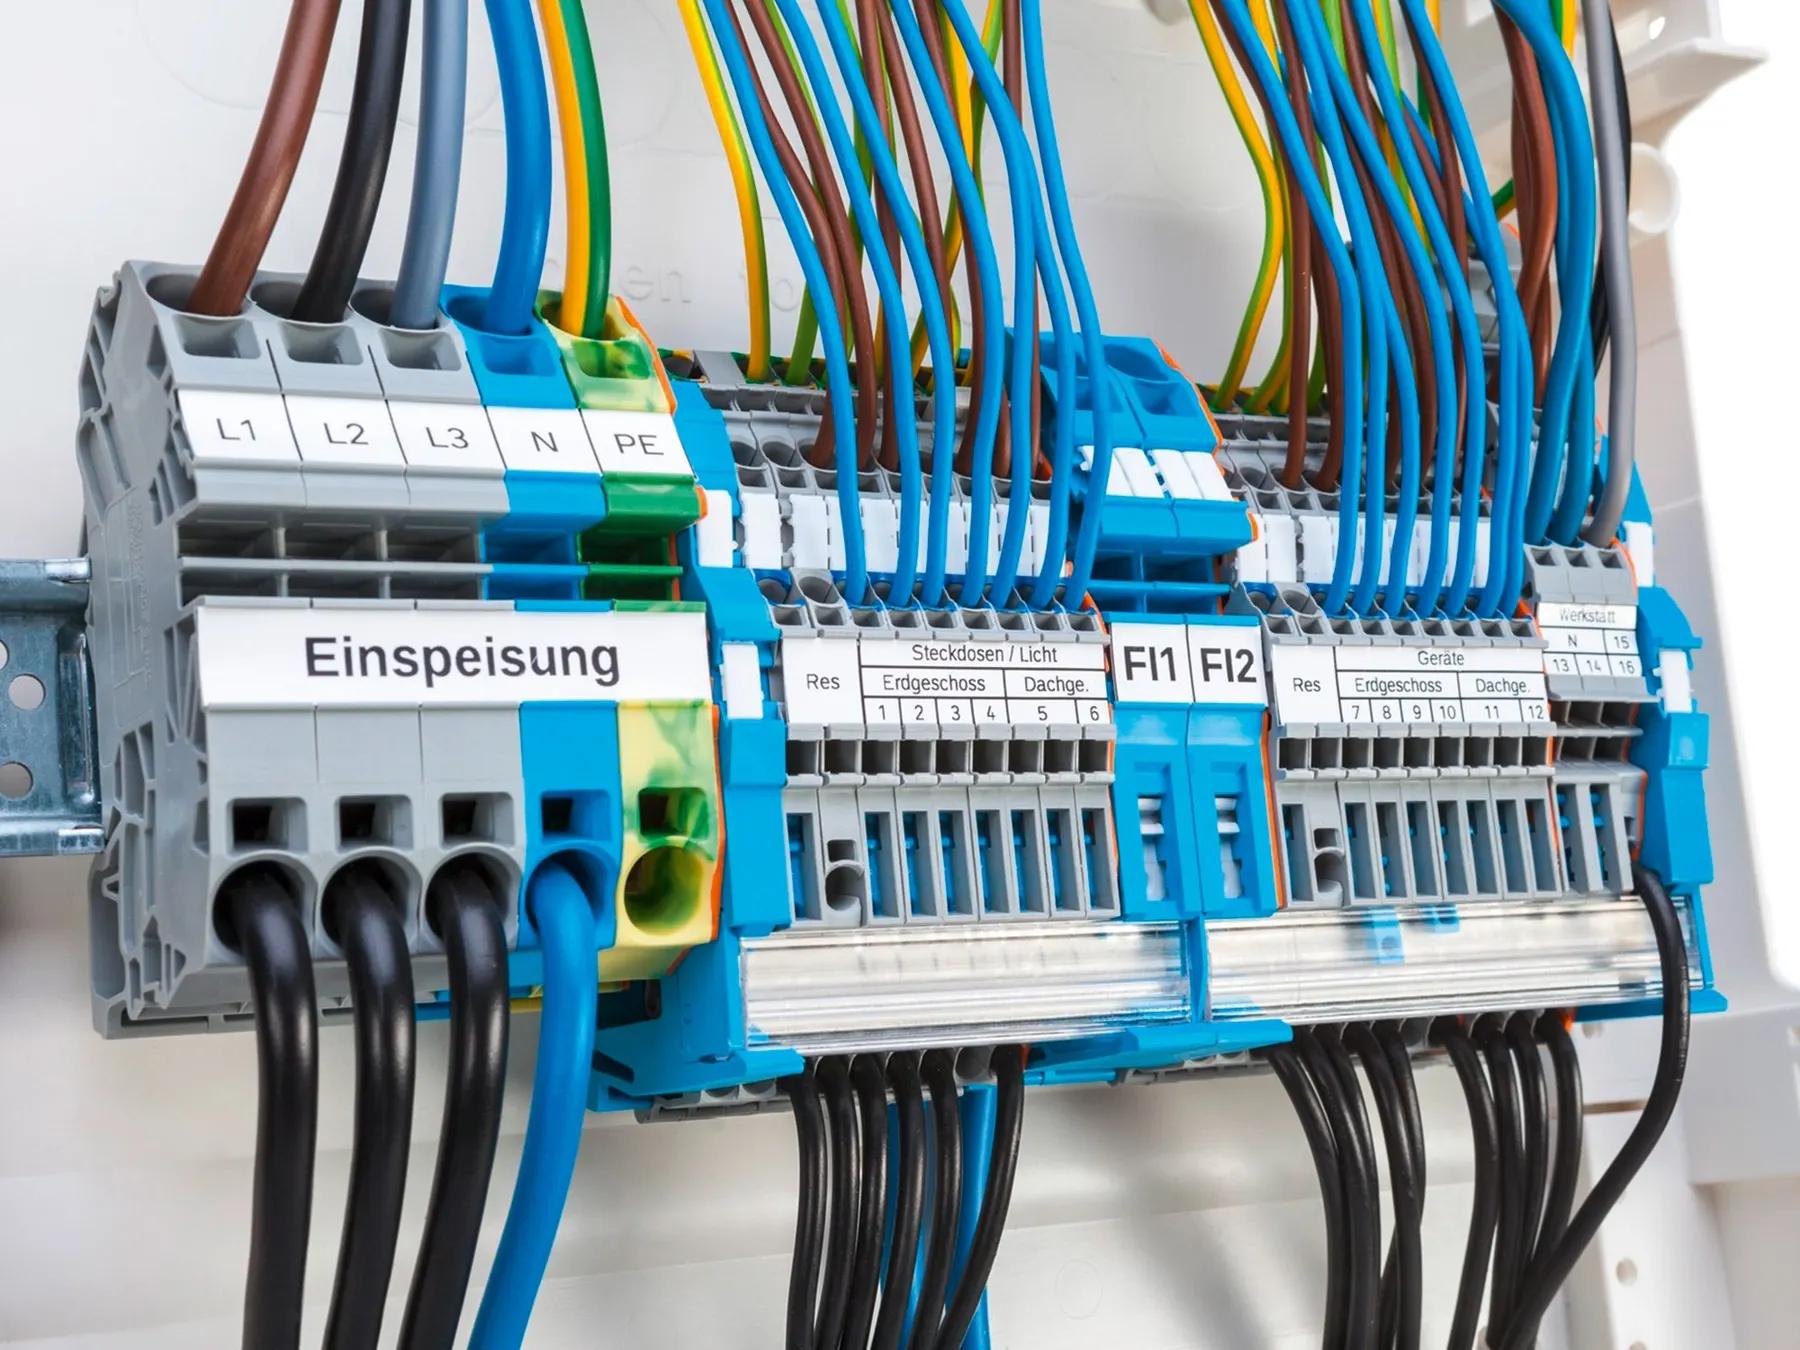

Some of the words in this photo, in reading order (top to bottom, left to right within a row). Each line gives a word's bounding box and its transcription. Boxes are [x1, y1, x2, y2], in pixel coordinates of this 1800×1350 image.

[216, 418, 257, 442] L1
[323, 422, 370, 446] L2
[425, 426, 470, 450] L3
[530, 431, 559, 453] N
[613, 433, 665, 456] PE
[1558, 608, 1618, 625] Werkstatt
[1567, 634, 1579, 648] N
[1612, 634, 1631, 650] 15
[305, 634, 621, 688] Einspeisung
[911, 643, 1005, 663] Steckdosen
[1018, 645, 1059, 664] Licht
[1416, 649, 1466, 668] Geräte
[1123, 645, 1178, 683] FI1
[1200, 647, 1259, 684] FI2
[1551, 657, 1571, 673] 13
[1585, 658, 1603, 674] 14
[1617, 659, 1637, 675] 16
[806, 672, 842, 691] Res
[882, 673, 987, 695] Erdgeschoss
[1023, 674, 1090, 697] Dachge.
[1292, 676, 1323, 694] Res
[1354, 676, 1444, 697] Erdgeschoss
[1474, 676, 1532, 697] Dachge.
[878, 704, 887, 722] 1
[913, 704, 926, 722] 2
[950, 704, 962, 722] 3
[985, 704, 997, 722] 4
[1037, 705, 1049, 722] 5
[1089, 705, 1101, 722] 6
[1350, 704, 1361, 721] 7
[1381, 704, 1393, 721] 8
[1412, 704, 1424, 721] 9
[1439, 704, 1457, 721] 10
[1484, 704, 1501, 721] 11
[1527, 704, 1545, 721] 12
